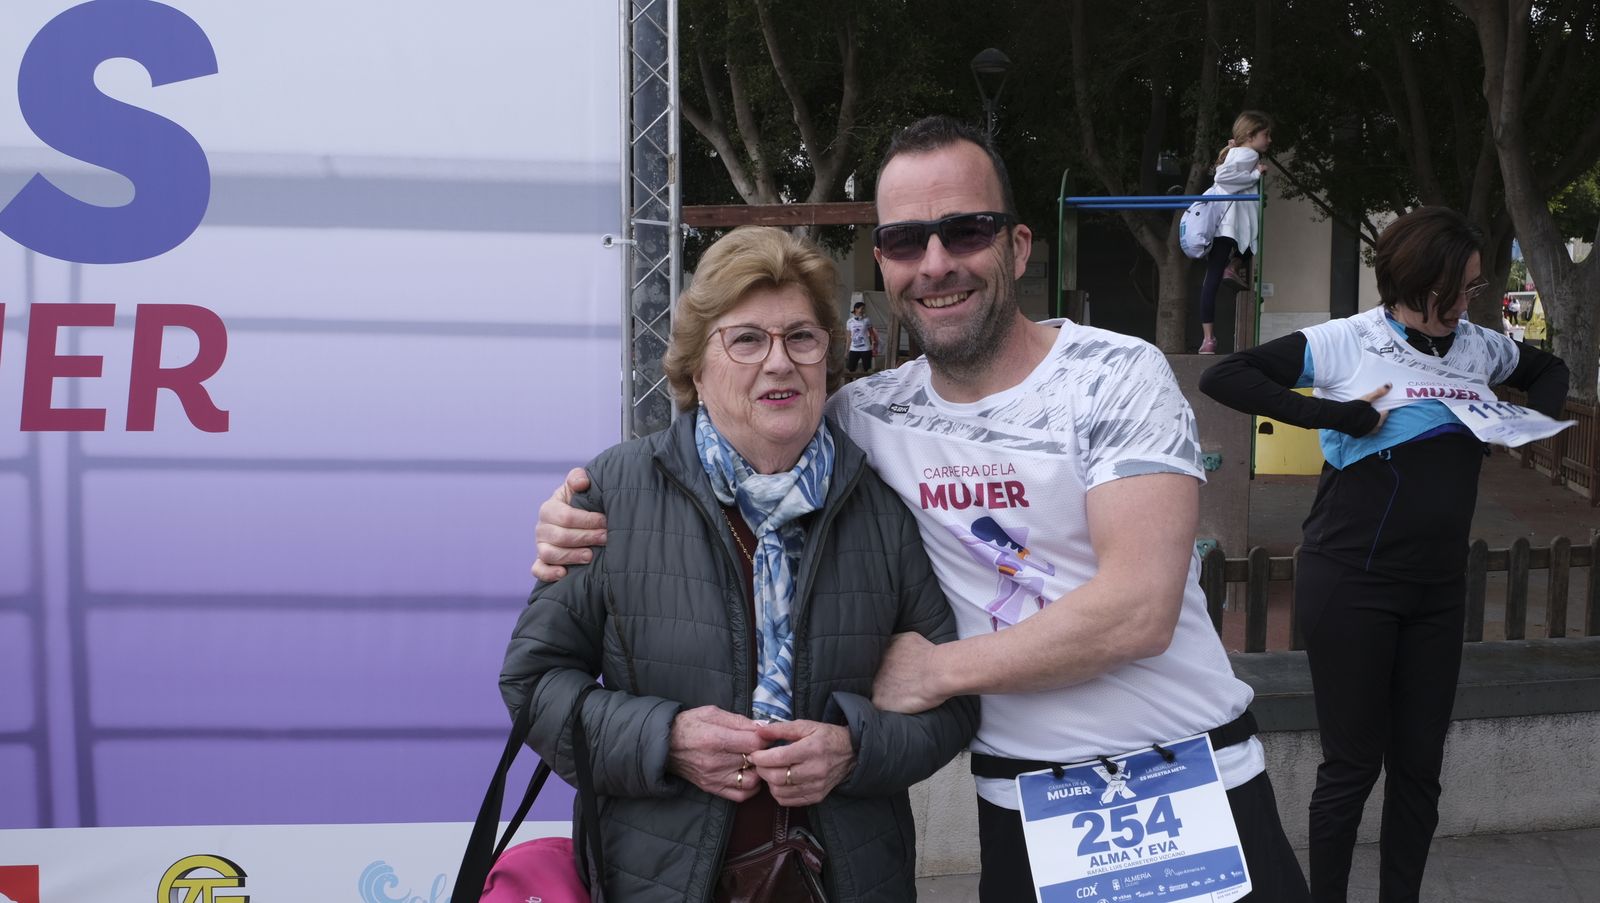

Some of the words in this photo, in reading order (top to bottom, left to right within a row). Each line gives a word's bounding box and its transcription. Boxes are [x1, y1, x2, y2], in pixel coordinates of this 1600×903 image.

[0, 0, 219, 265] S
[0, 302, 229, 434] ER
[1406, 388, 1481, 401] MUJER
[923, 465, 980, 480] CARRERA
[982, 463, 998, 477] DE
[1000, 462, 1016, 475] LA
[919, 480, 1030, 511] MUJER
[1147, 769, 1171, 779] NUESTRA
[1047, 786, 1092, 800] MUJER
[1049, 782, 1072, 790] CARRERA
[1072, 795, 1183, 857] 254
[1087, 866, 1108, 875] RAFAEL
[1109, 863, 1121, 871] LUIS
[1123, 856, 1158, 867] CARRETERO
[1158, 850, 1186, 861] VIZCAINO
[1090, 850, 1131, 868] ALMA
[1133, 847, 1143, 858] Y
[1148, 840, 1179, 856] EVA
[1124, 872, 1152, 883] ALMERÍA
[1076, 883, 1098, 899] CDX
